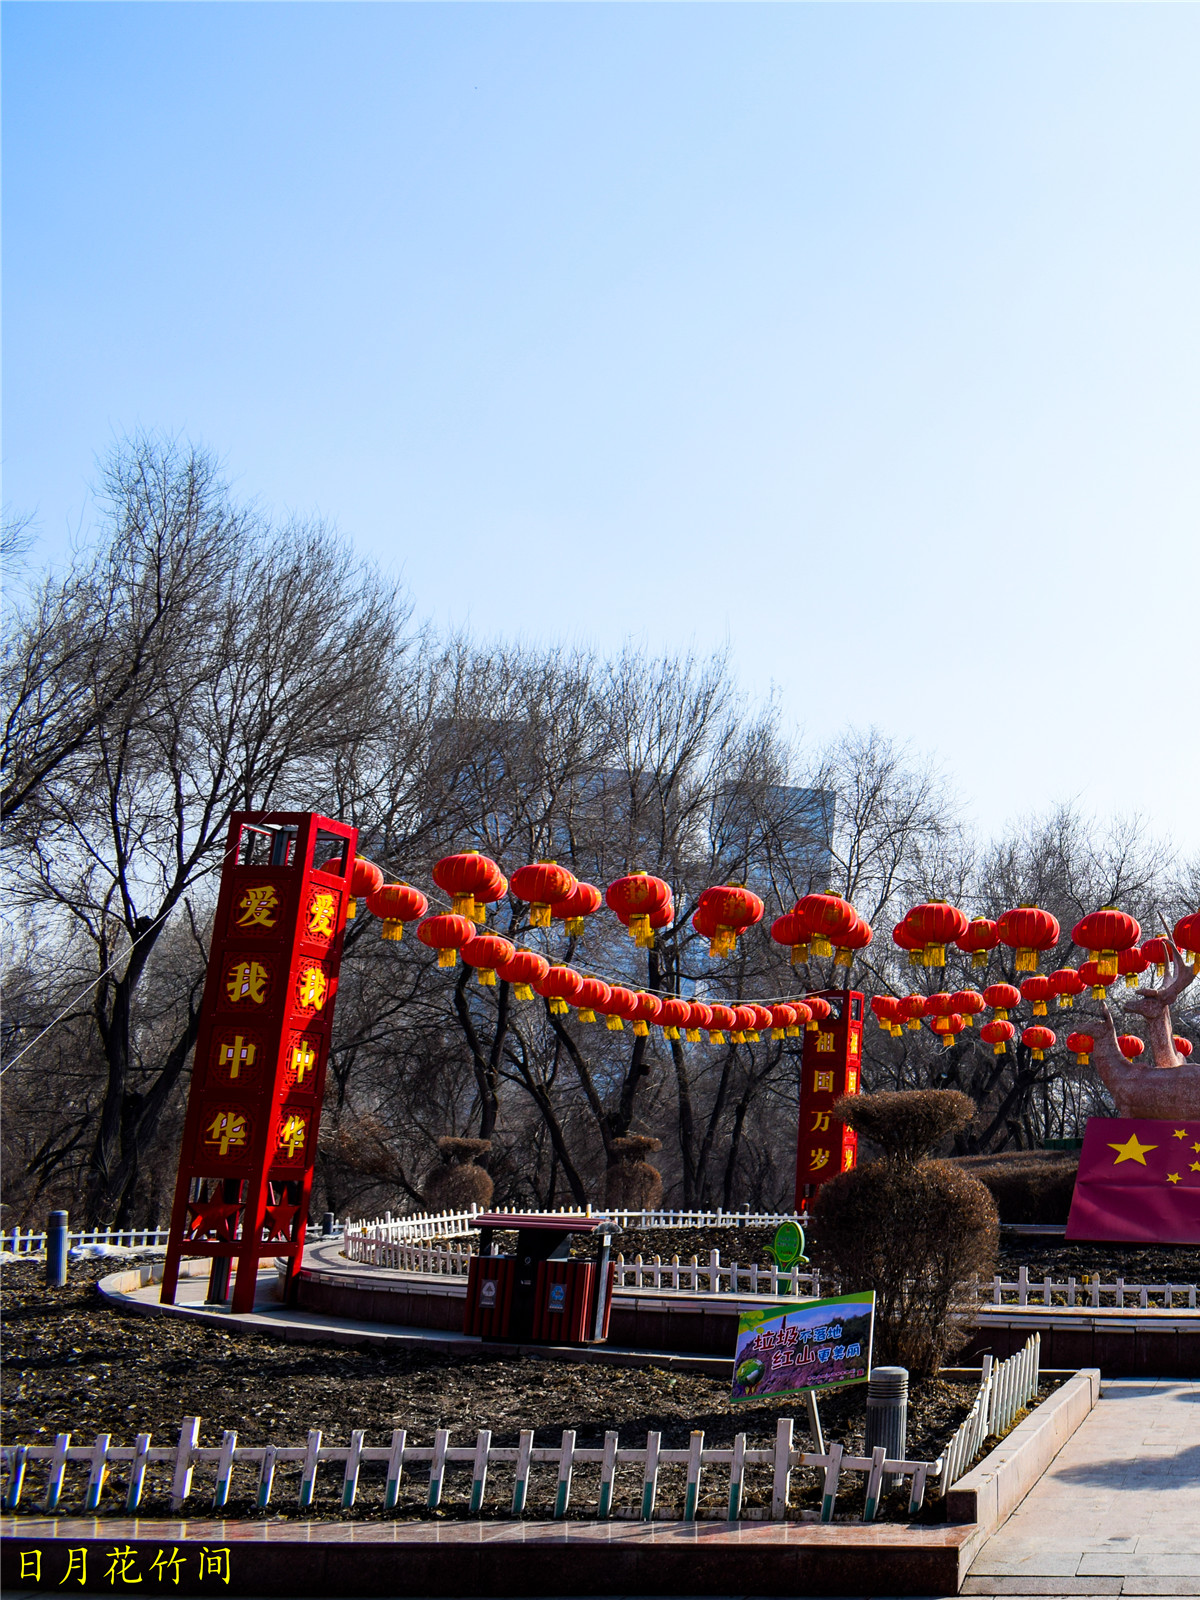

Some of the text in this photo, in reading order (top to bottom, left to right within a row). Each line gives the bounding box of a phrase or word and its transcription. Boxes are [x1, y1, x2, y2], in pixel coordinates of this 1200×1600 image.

[205, 884, 279, 1157] 爱我中华
[279, 892, 336, 1159] 爱我中华
[809, 1030, 836, 1172] 祖国万岁
[752, 1323, 843, 1352] 垃圾不落地
[771, 1342, 861, 1371] 红山更美丽
